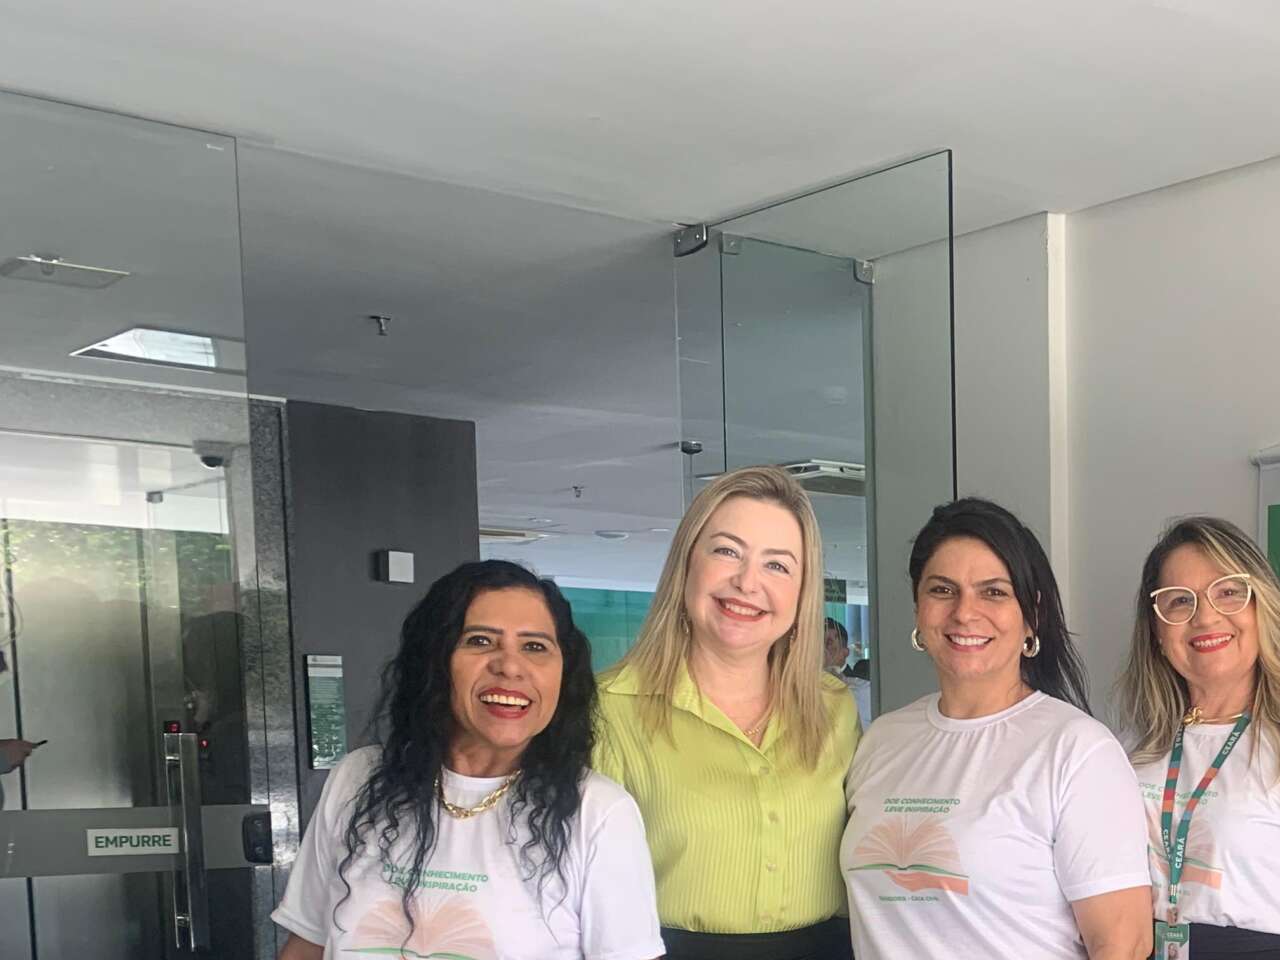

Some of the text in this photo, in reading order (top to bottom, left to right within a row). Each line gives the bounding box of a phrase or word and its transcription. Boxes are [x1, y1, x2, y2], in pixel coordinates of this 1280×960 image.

[1222, 731, 1242, 757] CEARÁ
[94, 834, 173, 849] EMPURRE
[1174, 836, 1186, 869] CEARÁ
